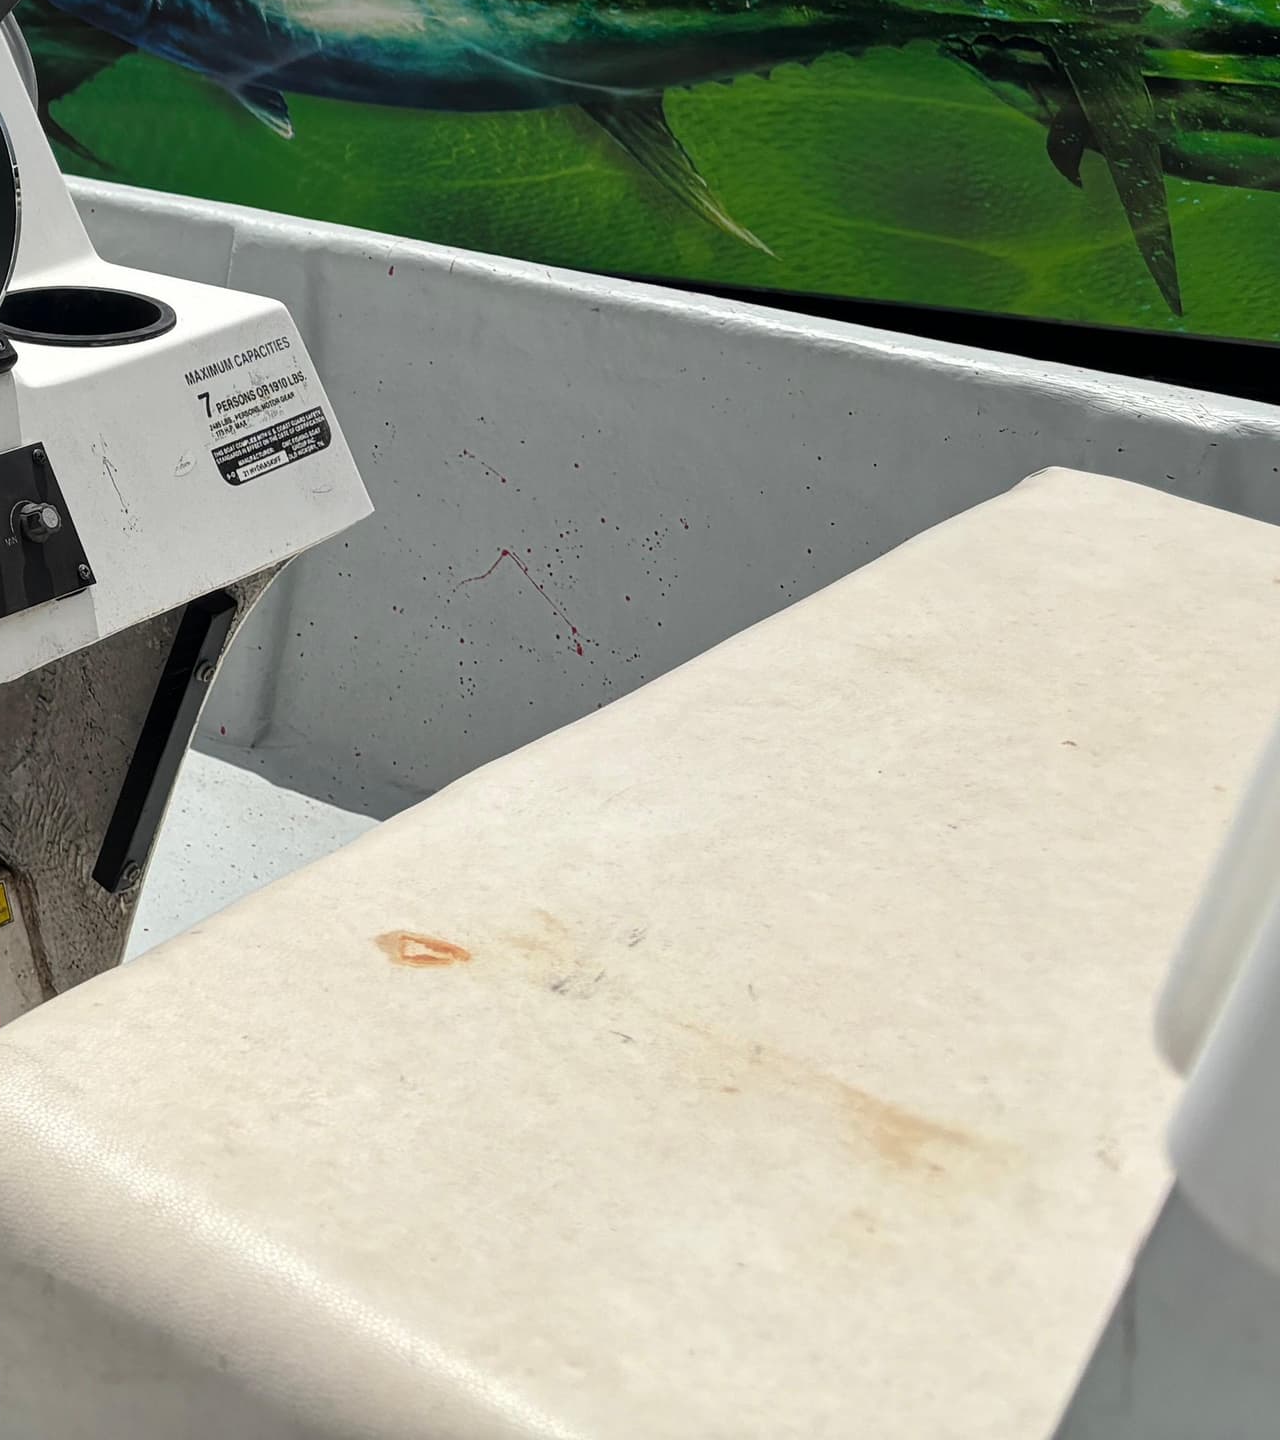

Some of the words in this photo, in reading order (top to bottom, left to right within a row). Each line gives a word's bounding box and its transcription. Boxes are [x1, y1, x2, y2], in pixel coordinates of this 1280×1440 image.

[185, 358, 234, 386] MAXIMUM
[234, 336, 290, 368] CAPACITIES
[197, 392, 212, 418] 7
[216, 390, 256, 414] PERSONS
[256, 385, 269, 398] OR
